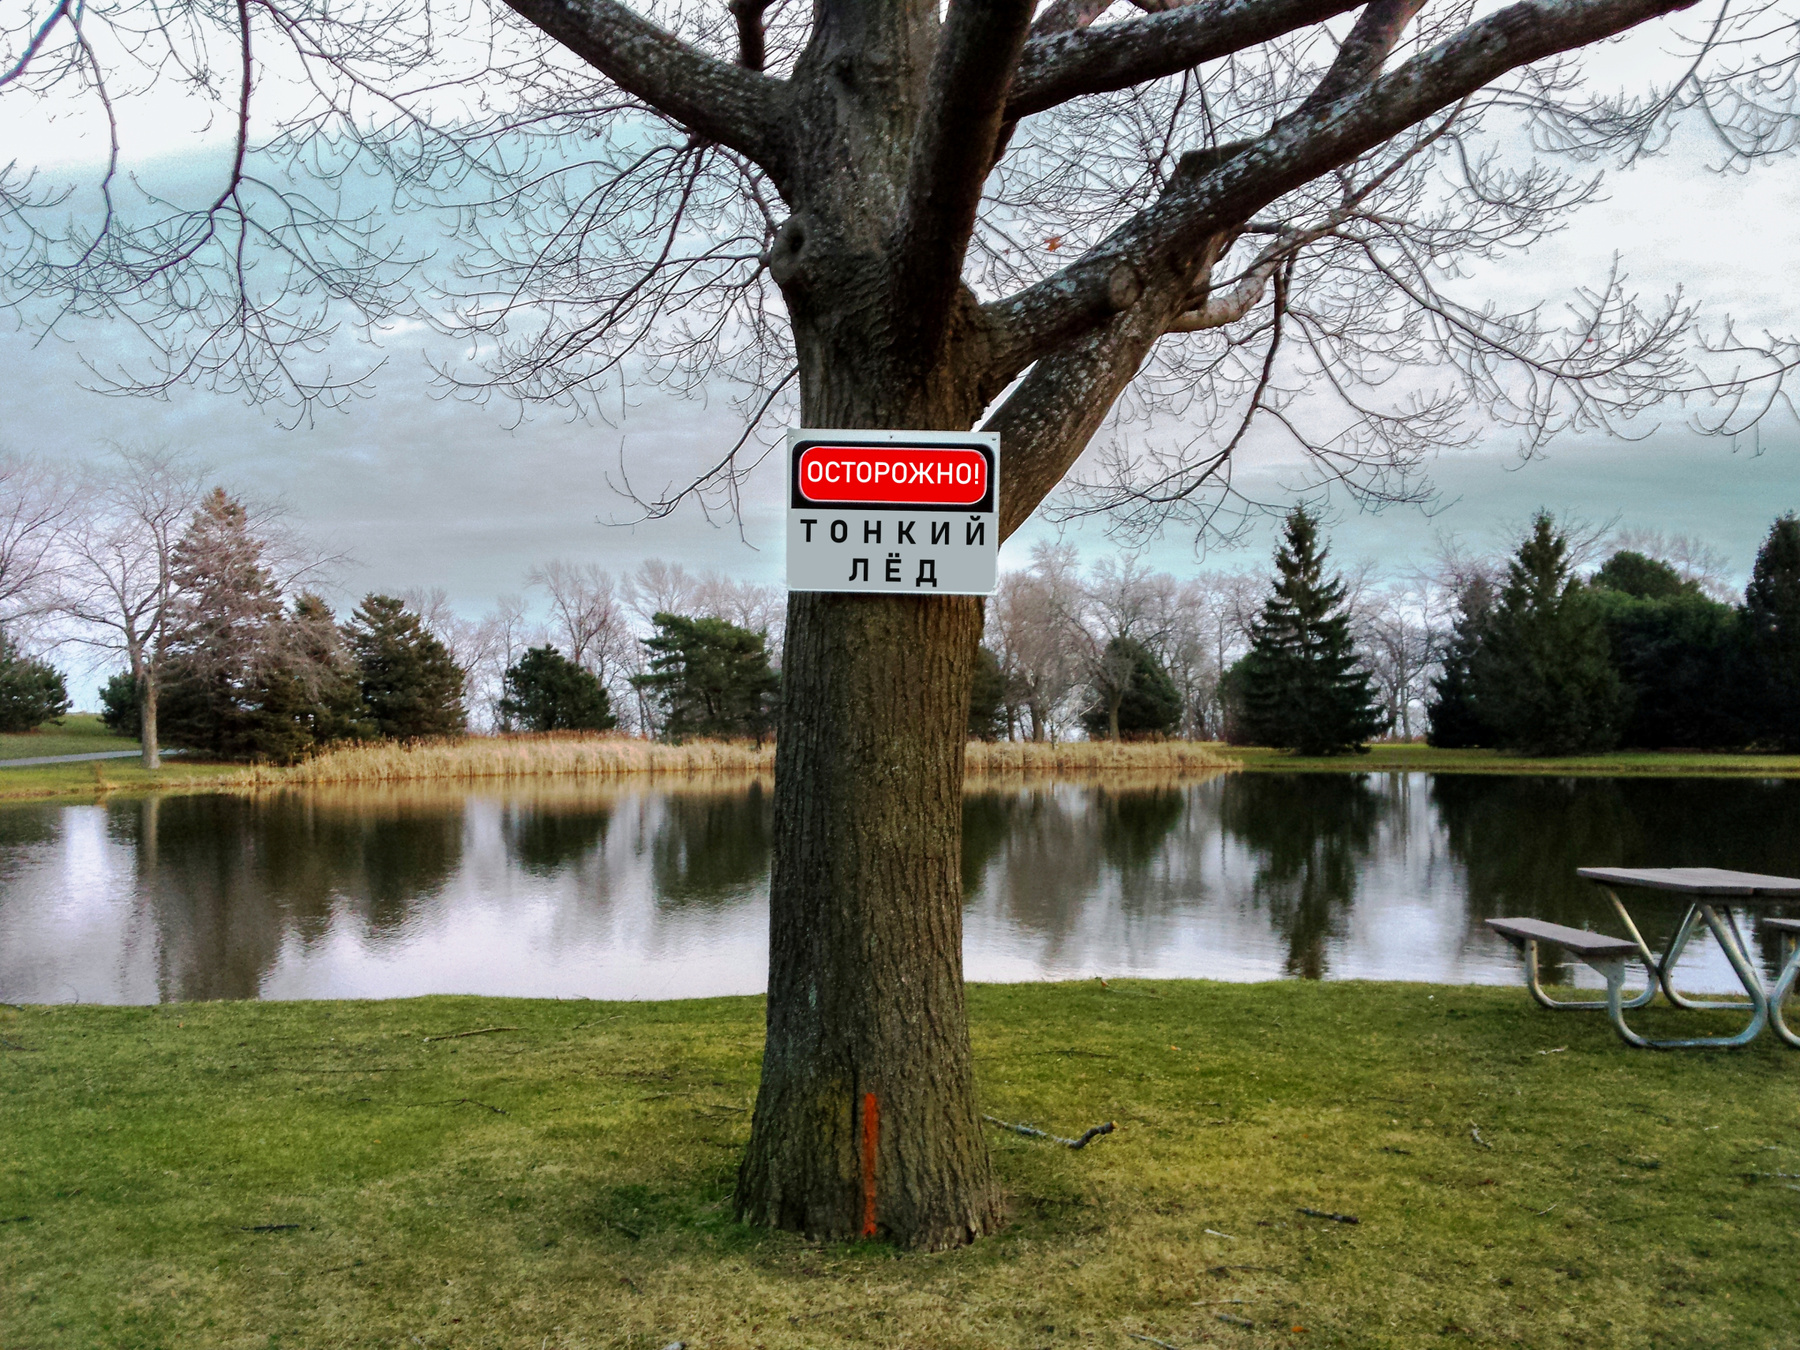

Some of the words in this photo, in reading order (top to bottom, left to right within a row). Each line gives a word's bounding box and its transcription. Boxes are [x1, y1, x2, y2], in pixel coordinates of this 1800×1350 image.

[807, 460, 980, 485] ОСТОРОЖНО!
[800, 515, 985, 546] ТОНКИЙ
[848, 552, 938, 588] ЛЁД
